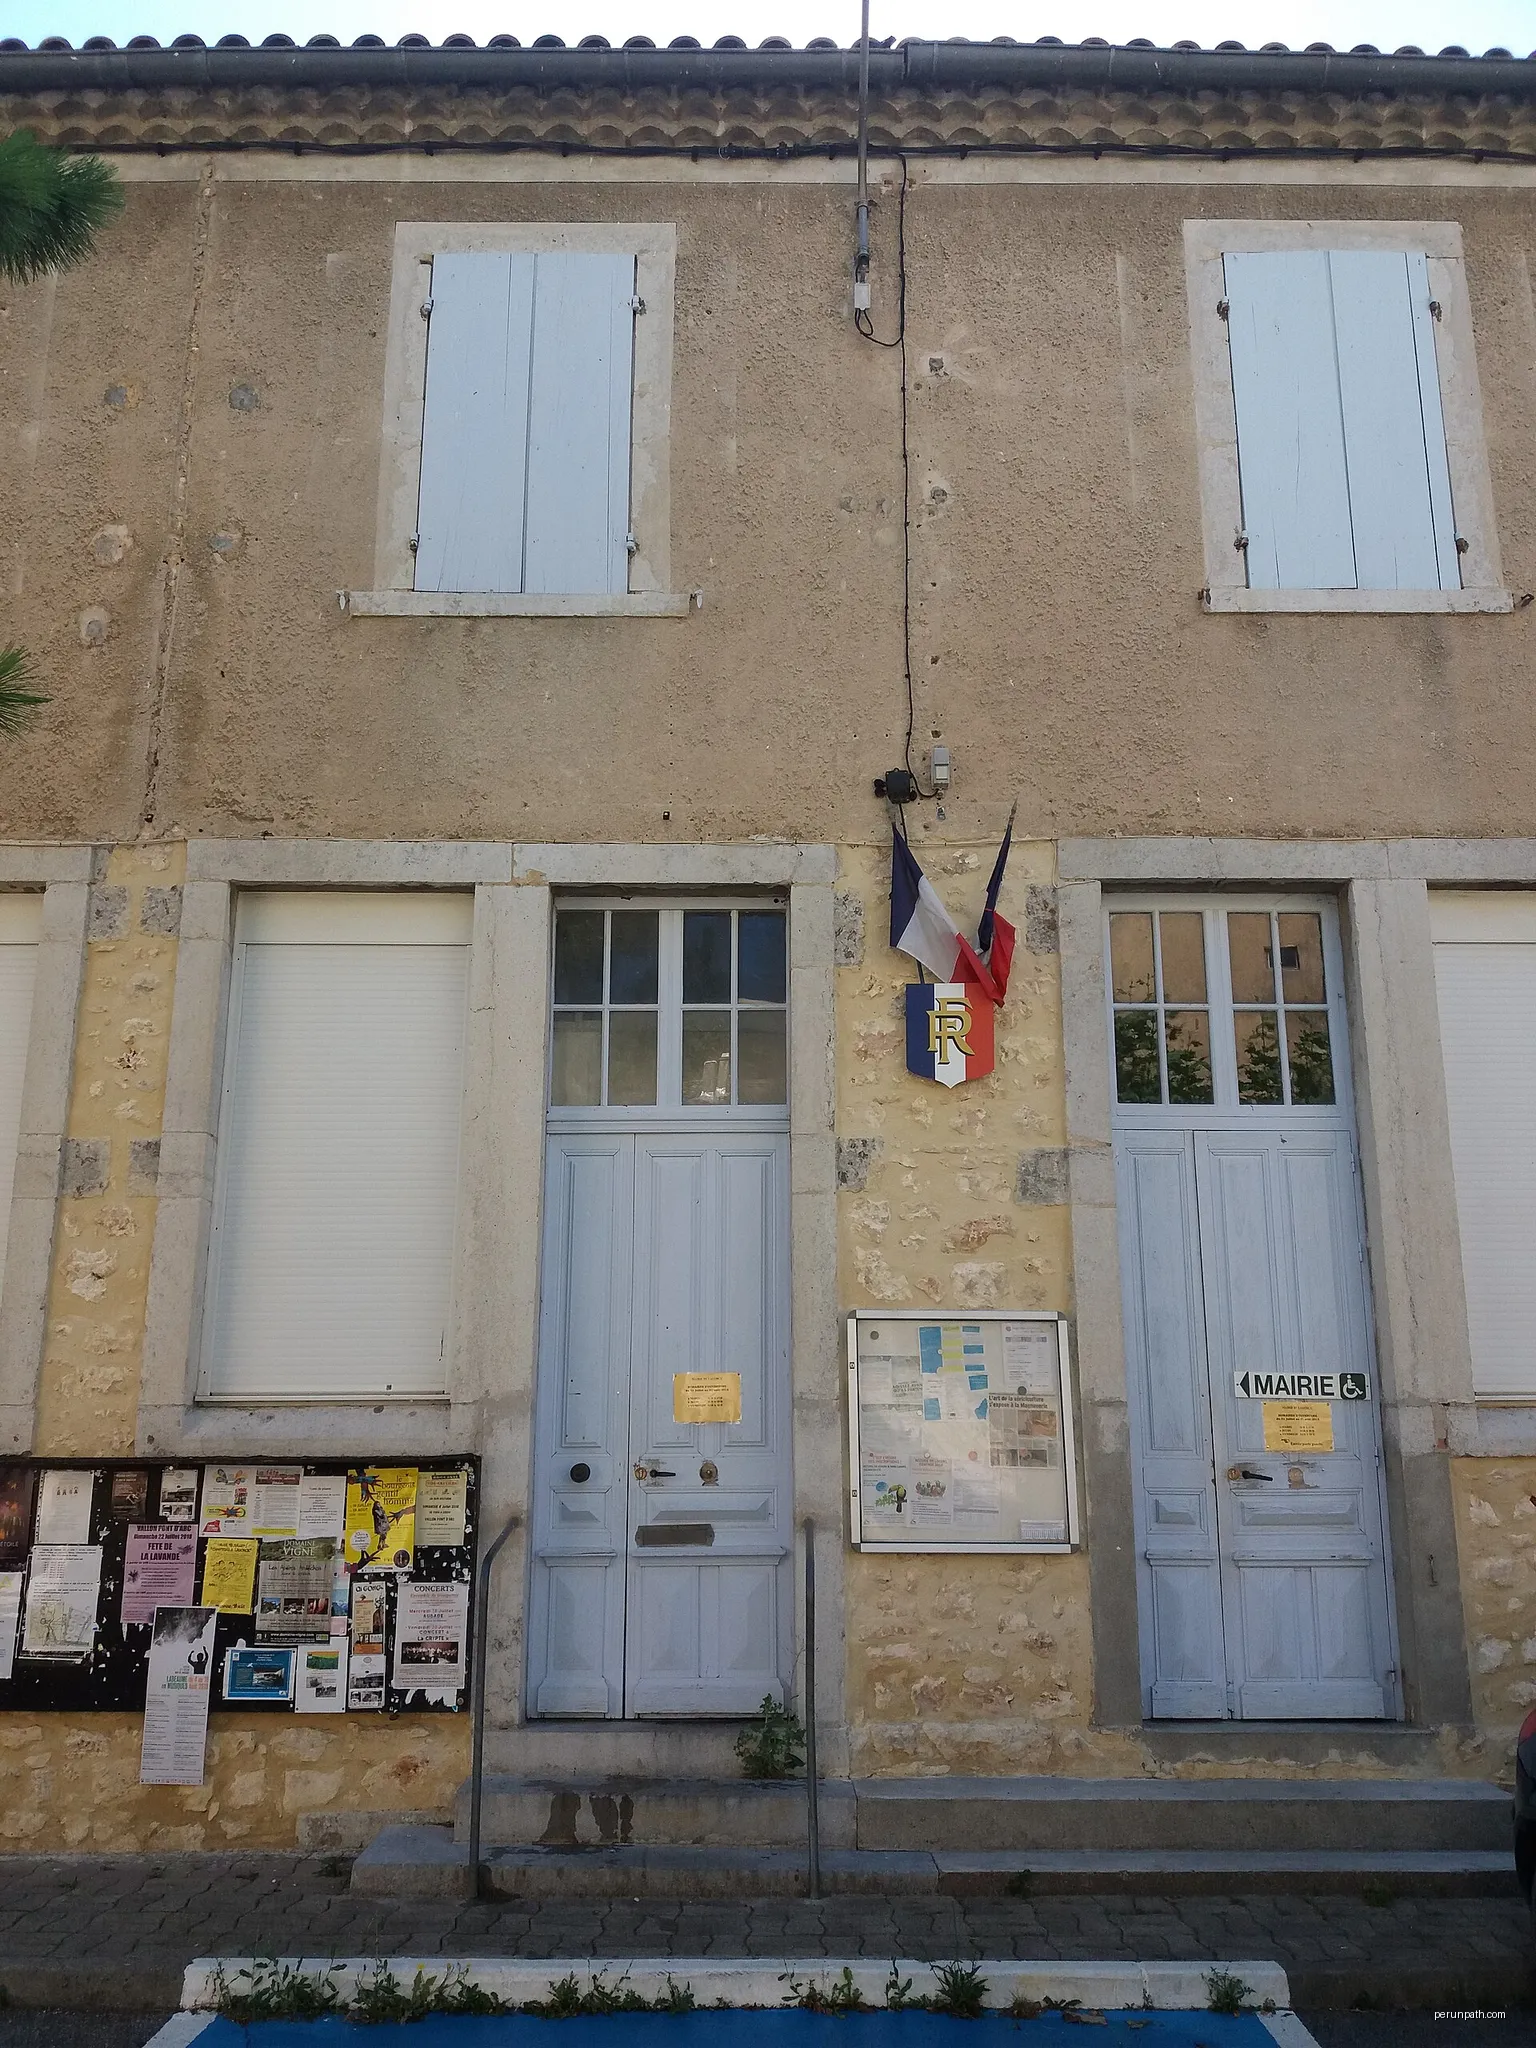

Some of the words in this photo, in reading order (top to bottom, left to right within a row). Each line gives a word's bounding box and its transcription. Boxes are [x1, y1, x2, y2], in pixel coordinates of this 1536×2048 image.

[1254, 1374, 1335, 1397] MAIRIE
[381, 1481, 415, 1491] bourgeois
[377, 1490, 399, 1500] gentil
[383, 1496, 414, 1505] homme
[283, 1546, 315, 1556] VIGNE
